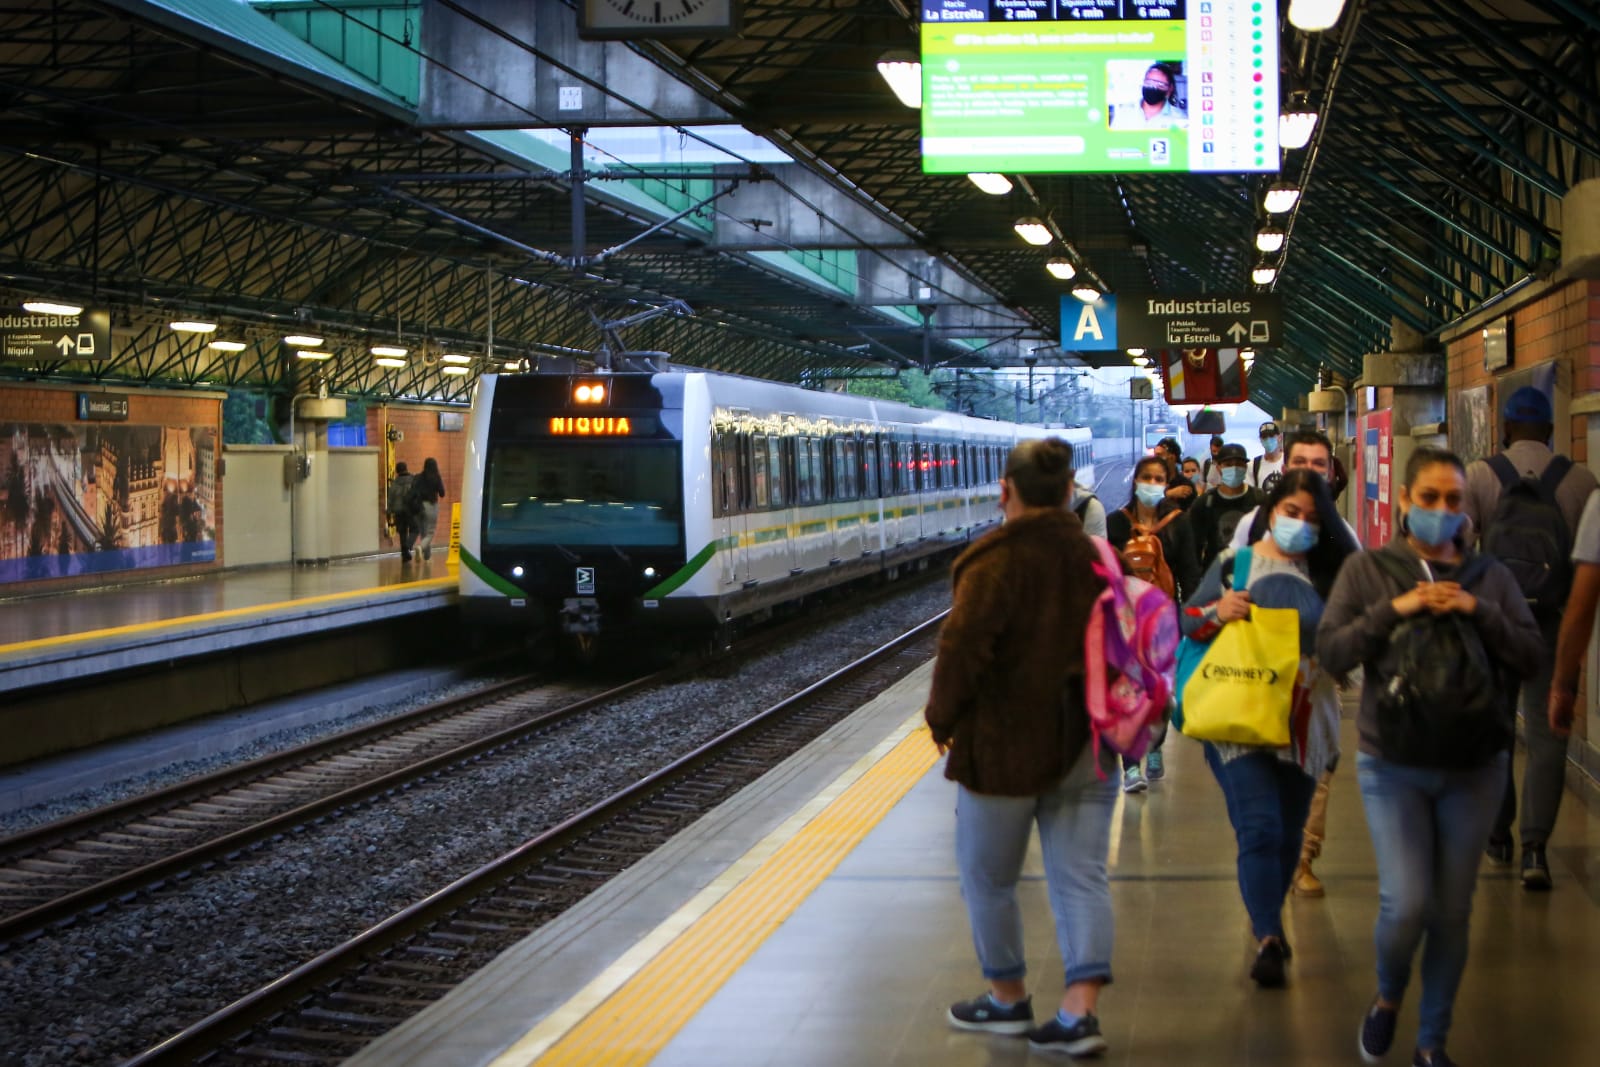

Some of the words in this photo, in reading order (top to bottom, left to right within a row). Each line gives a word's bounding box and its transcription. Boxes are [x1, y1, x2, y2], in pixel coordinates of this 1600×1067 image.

[926, 9, 939, 19] La
[941, 9, 985, 19] Estrella
[1005, 9, 1014, 19] 2
[1016, 8, 1037, 19] min
[1071, 7, 1080, 18] 4
[1082, 7, 1104, 18] min
[1138, 7, 1147, 18] 6
[1149, 6, 1171, 18] min
[1148, 298, 1251, 315] Industriales
[1073, 303, 1103, 341] A
[1170, 334, 1181, 343] La
[1184, 333, 1221, 343] Estrella
[7, 346, 34, 357] Niquía
[81, 397, 87, 416] A
[551, 417, 630, 434] NIQUIA
